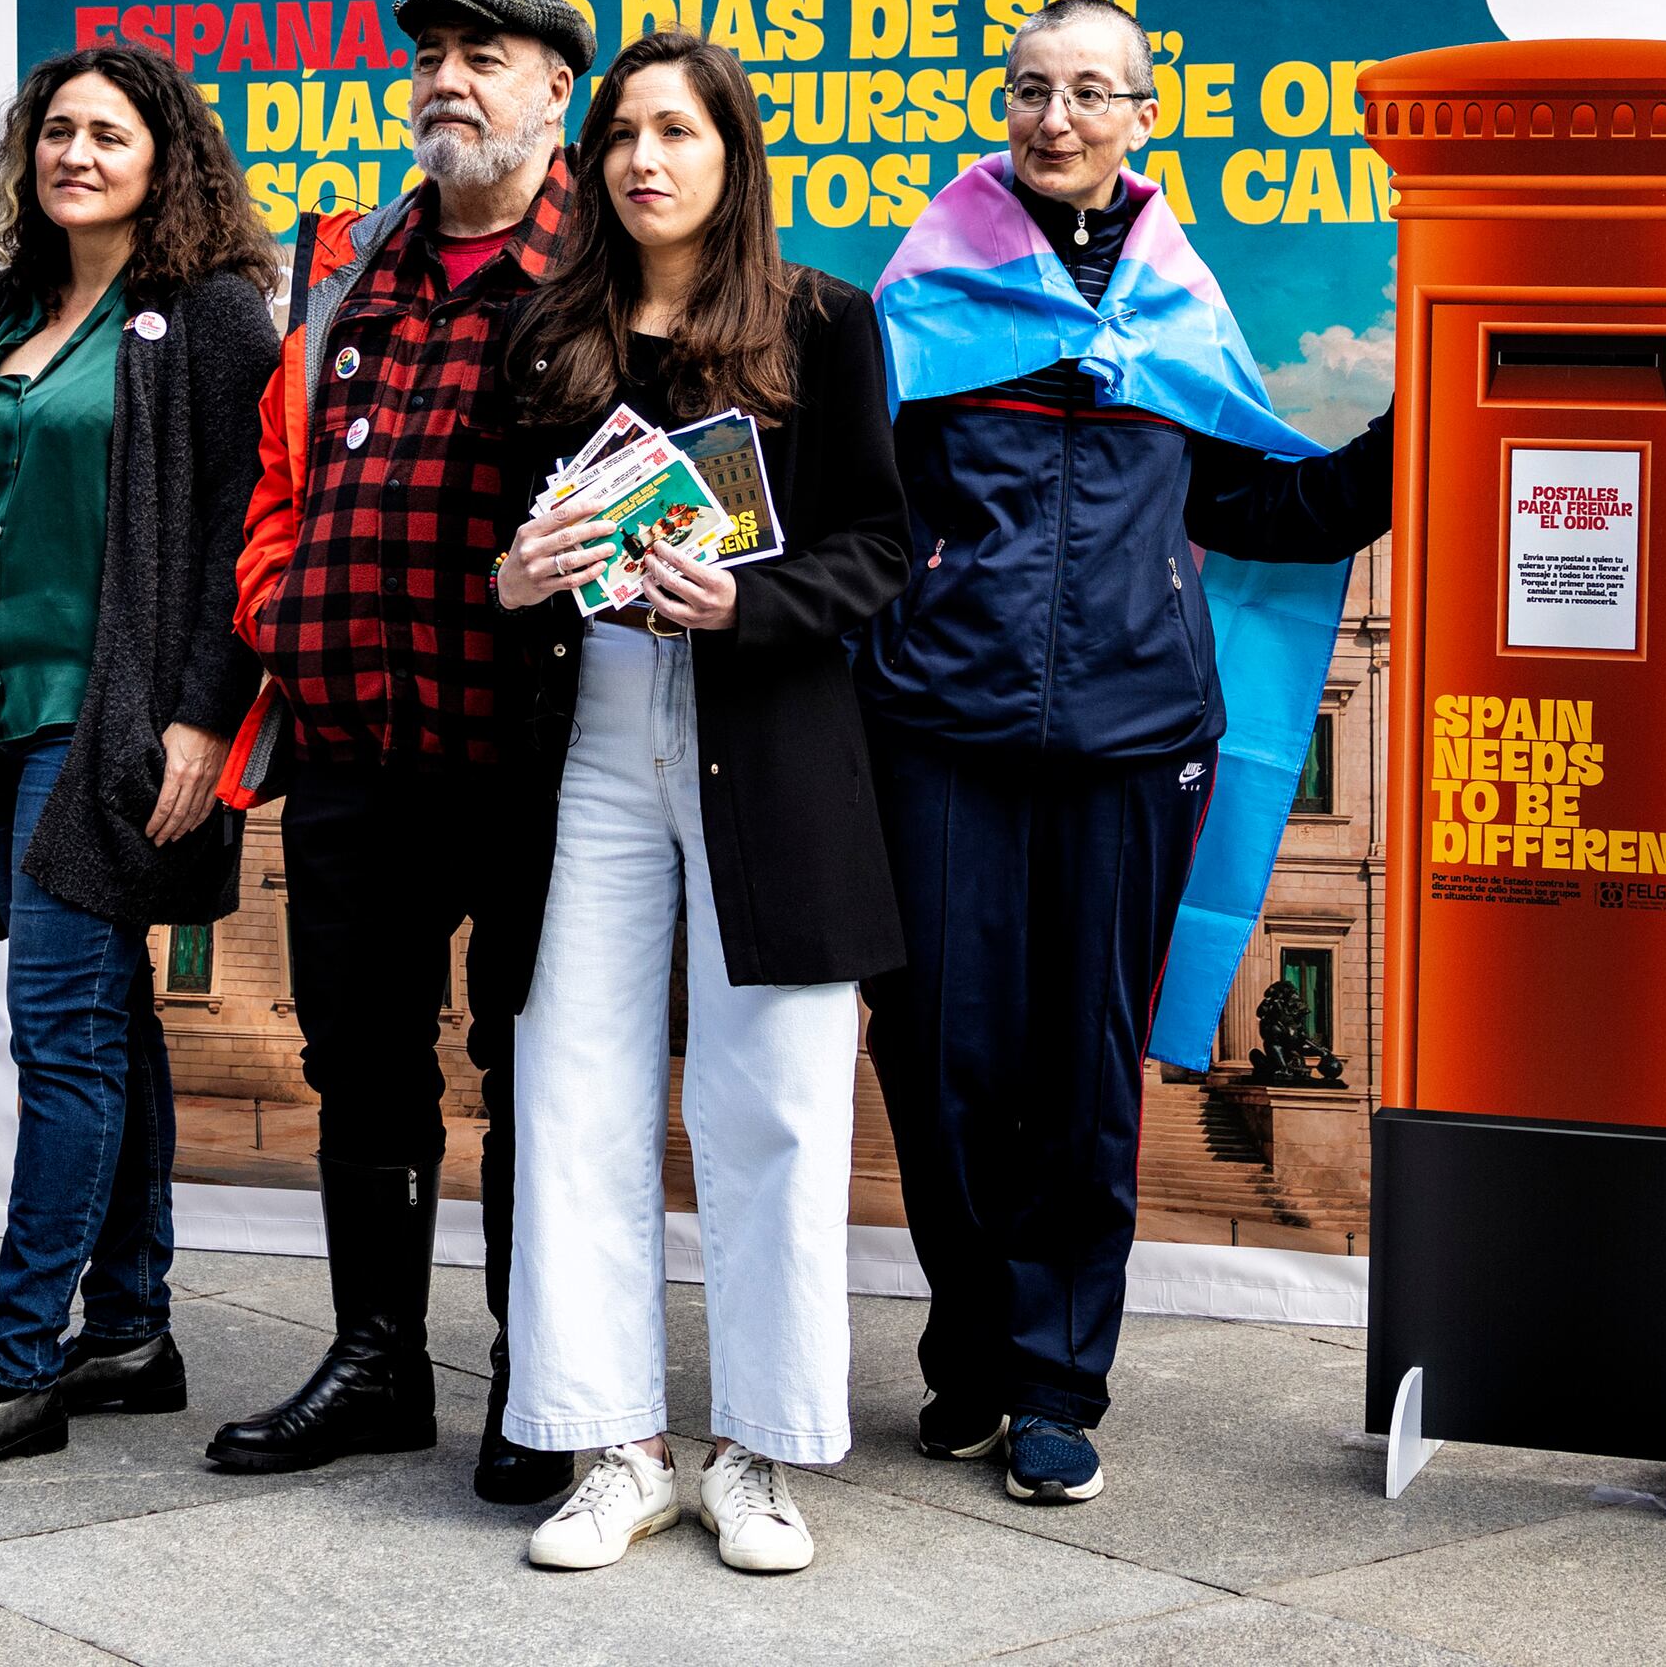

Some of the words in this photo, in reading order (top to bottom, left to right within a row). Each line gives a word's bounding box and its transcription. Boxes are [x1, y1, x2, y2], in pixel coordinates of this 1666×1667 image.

[1533, 486, 1618, 502] POSTALES
[1517, 499, 1562, 514] PARA
[1567, 501, 1633, 517] FRENAR
[1540, 515, 1559, 529] EL
[1563, 515, 1609, 530] ODIO.
[1517, 562, 1545, 570] quieras
[1561, 555, 1584, 563] postal
[1592, 556, 1613, 564] quien
[1520, 571, 1551, 579] mensaje
[1522, 579, 1549, 587] Porque
[1559, 580, 1584, 588] primer
[1586, 582, 1604, 590] paso
[1433, 694, 1593, 743] SPAIN
[1433, 736, 1604, 786] NEEDS
[1183, 762, 1203, 775] NIKE
[1431, 778, 1500, 823] TO
[1516, 782, 1580, 828] BE
[1432, 873, 1448, 881] Por
[1463, 874, 1488, 883] Pacto
[1490, 876, 1501, 884] de
[1431, 882, 1473, 892] discursos
[1475, 884, 1485, 892] de
[1488, 885, 1508, 894] odio
[1550, 889, 1581, 899] grupos
[1445, 892, 1483, 901] situación
[1485, 894, 1496, 902] de
